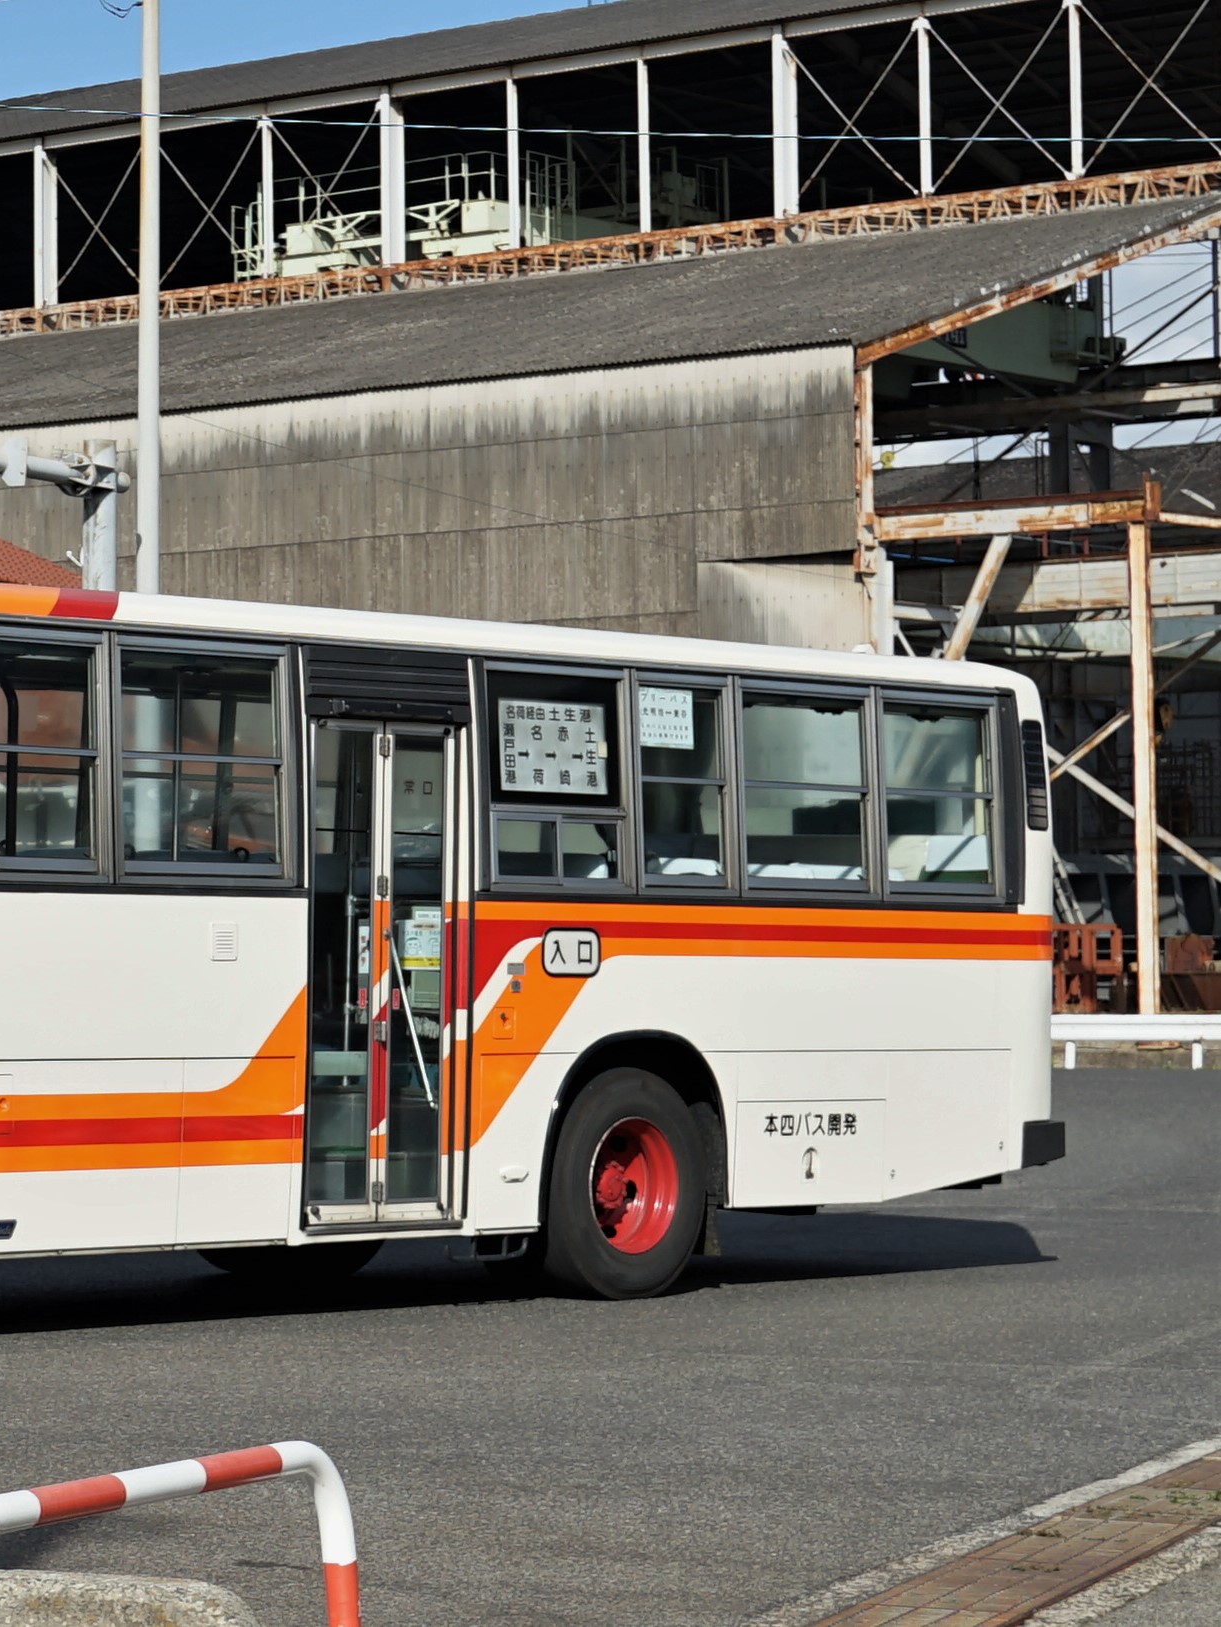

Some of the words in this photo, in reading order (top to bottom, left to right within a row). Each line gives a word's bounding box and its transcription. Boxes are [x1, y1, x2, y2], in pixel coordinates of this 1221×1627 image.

[550, 940, 592, 964] 入口
[764, 1112, 857, 1136] 本四バス開発
